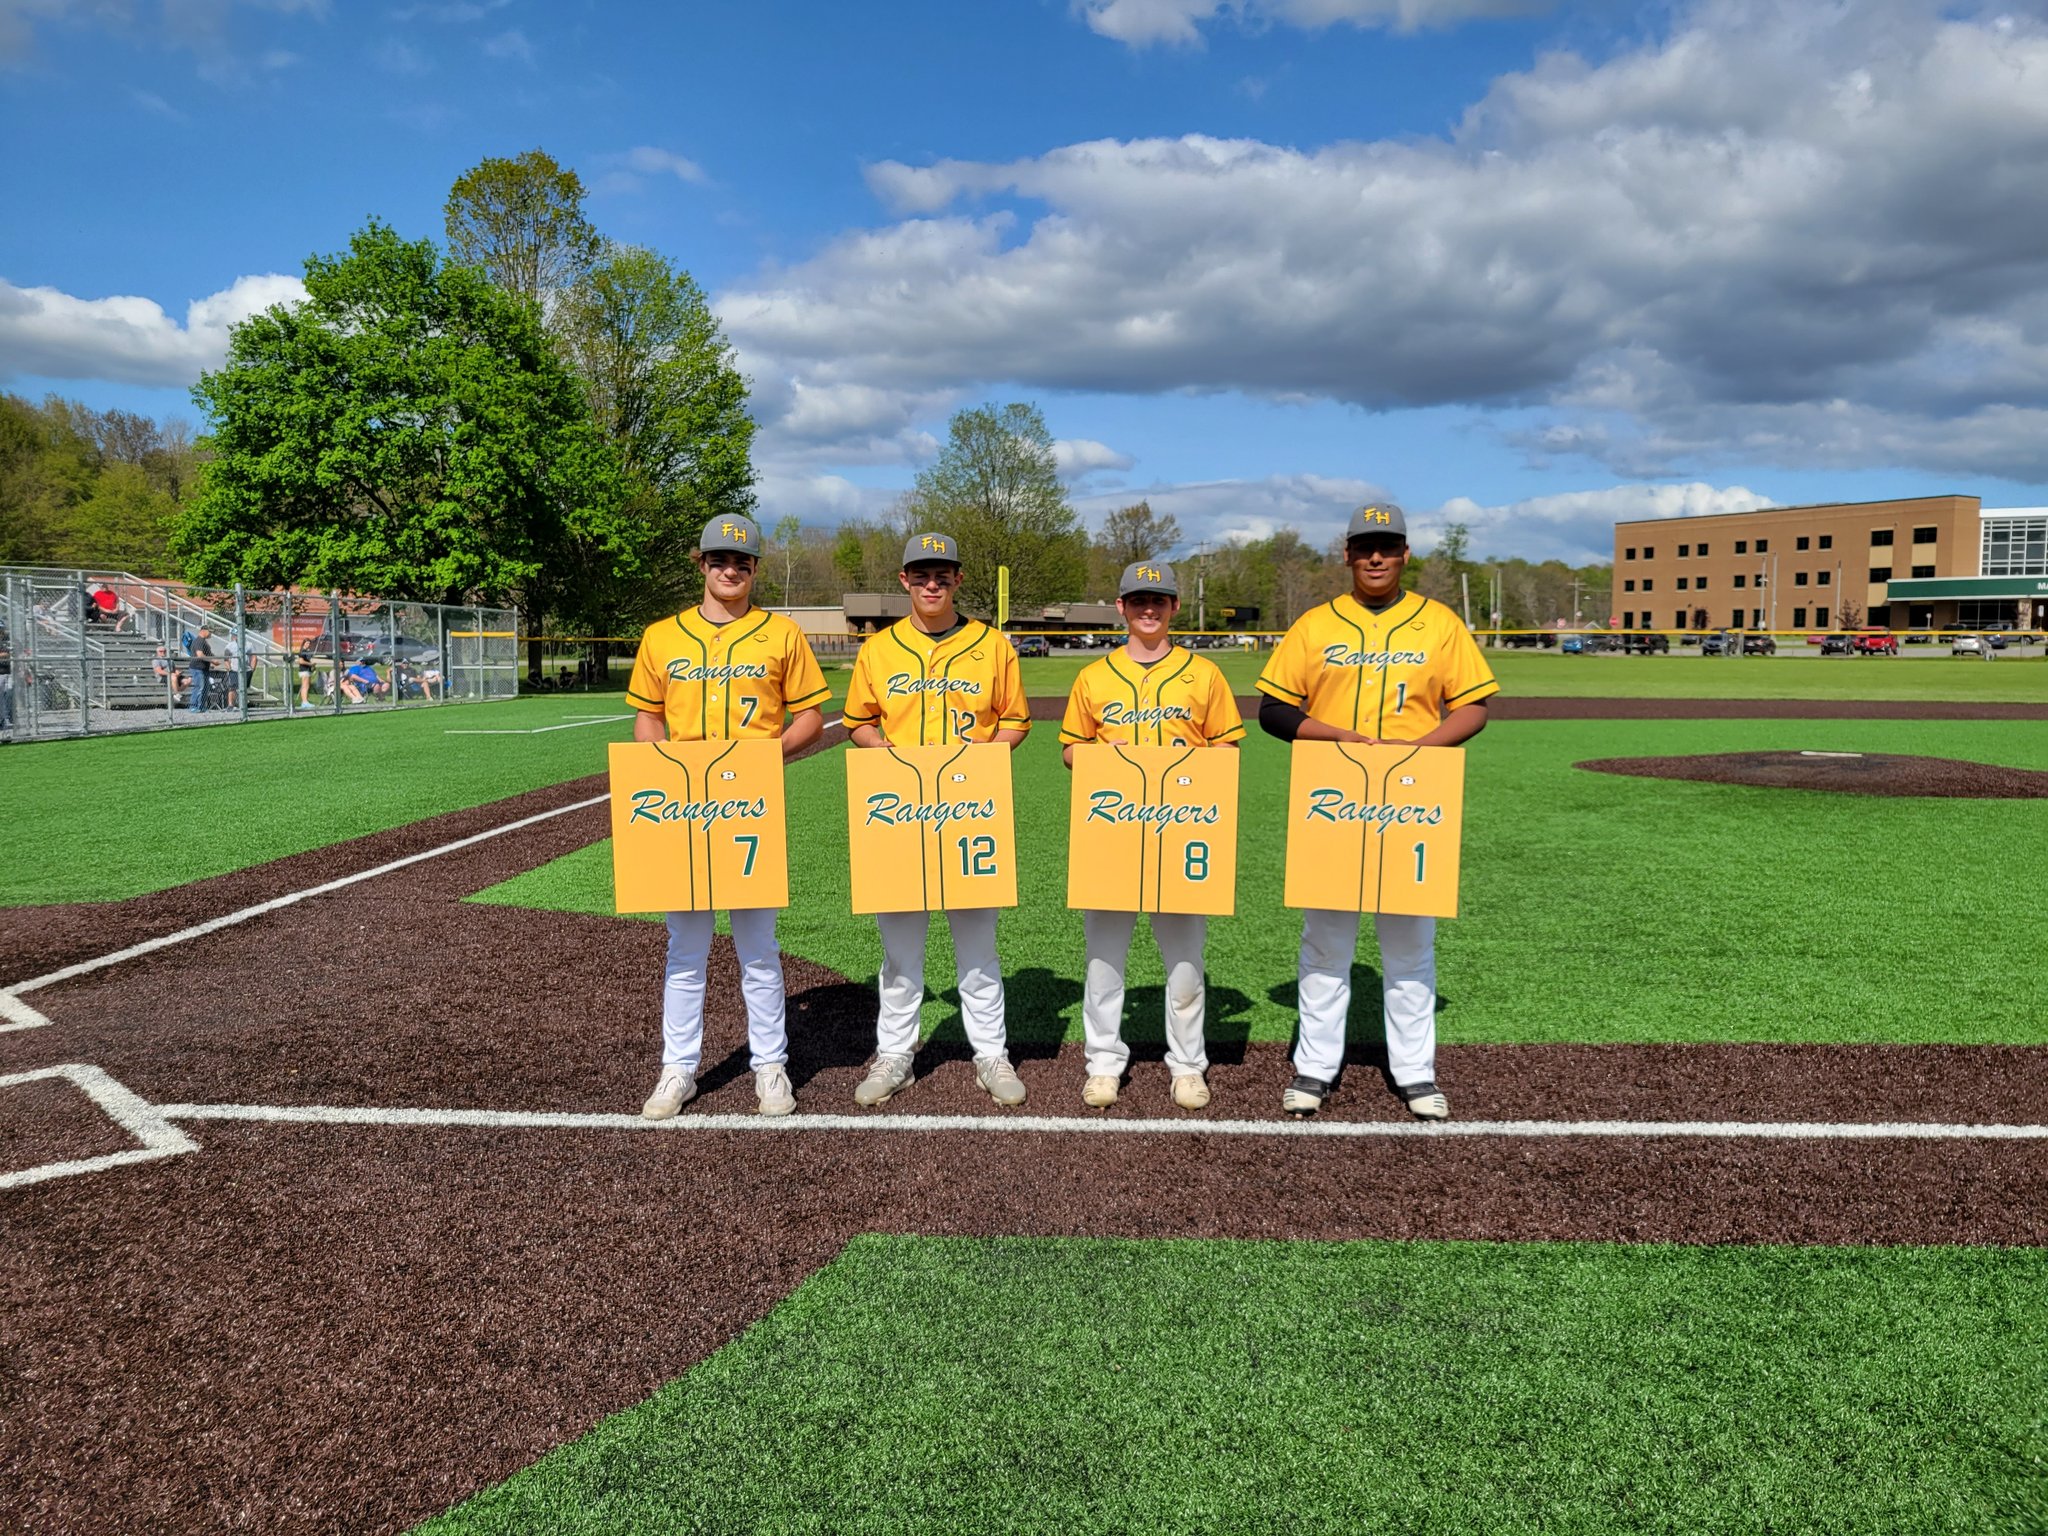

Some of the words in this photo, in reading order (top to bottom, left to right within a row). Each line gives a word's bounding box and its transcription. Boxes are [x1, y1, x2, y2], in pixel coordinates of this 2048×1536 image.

[1364, 507, 1391, 525] FH
[722, 522, 747, 543] FH
[921, 536, 946, 554] FH
[1135, 566, 1162, 583] FH
[666, 658, 768, 685] Rangers
[1323, 644, 1427, 673] Rangers
[886, 672, 982, 699] Rangers
[1395, 682, 1407, 714] 1
[739, 696, 758, 728] 7
[950, 708, 976, 743] 12
[1102, 701, 1192, 729] Rangers
[629, 789, 768, 831] Rangers
[865, 792, 997, 832] Rangers
[1087, 790, 1219, 834] Rangers
[1305, 787, 1445, 835] Rangers
[733, 835, 760, 877] 7
[957, 835, 998, 876] 12
[1184, 841, 1209, 881] 8
[1412, 842, 1426, 883] 1
